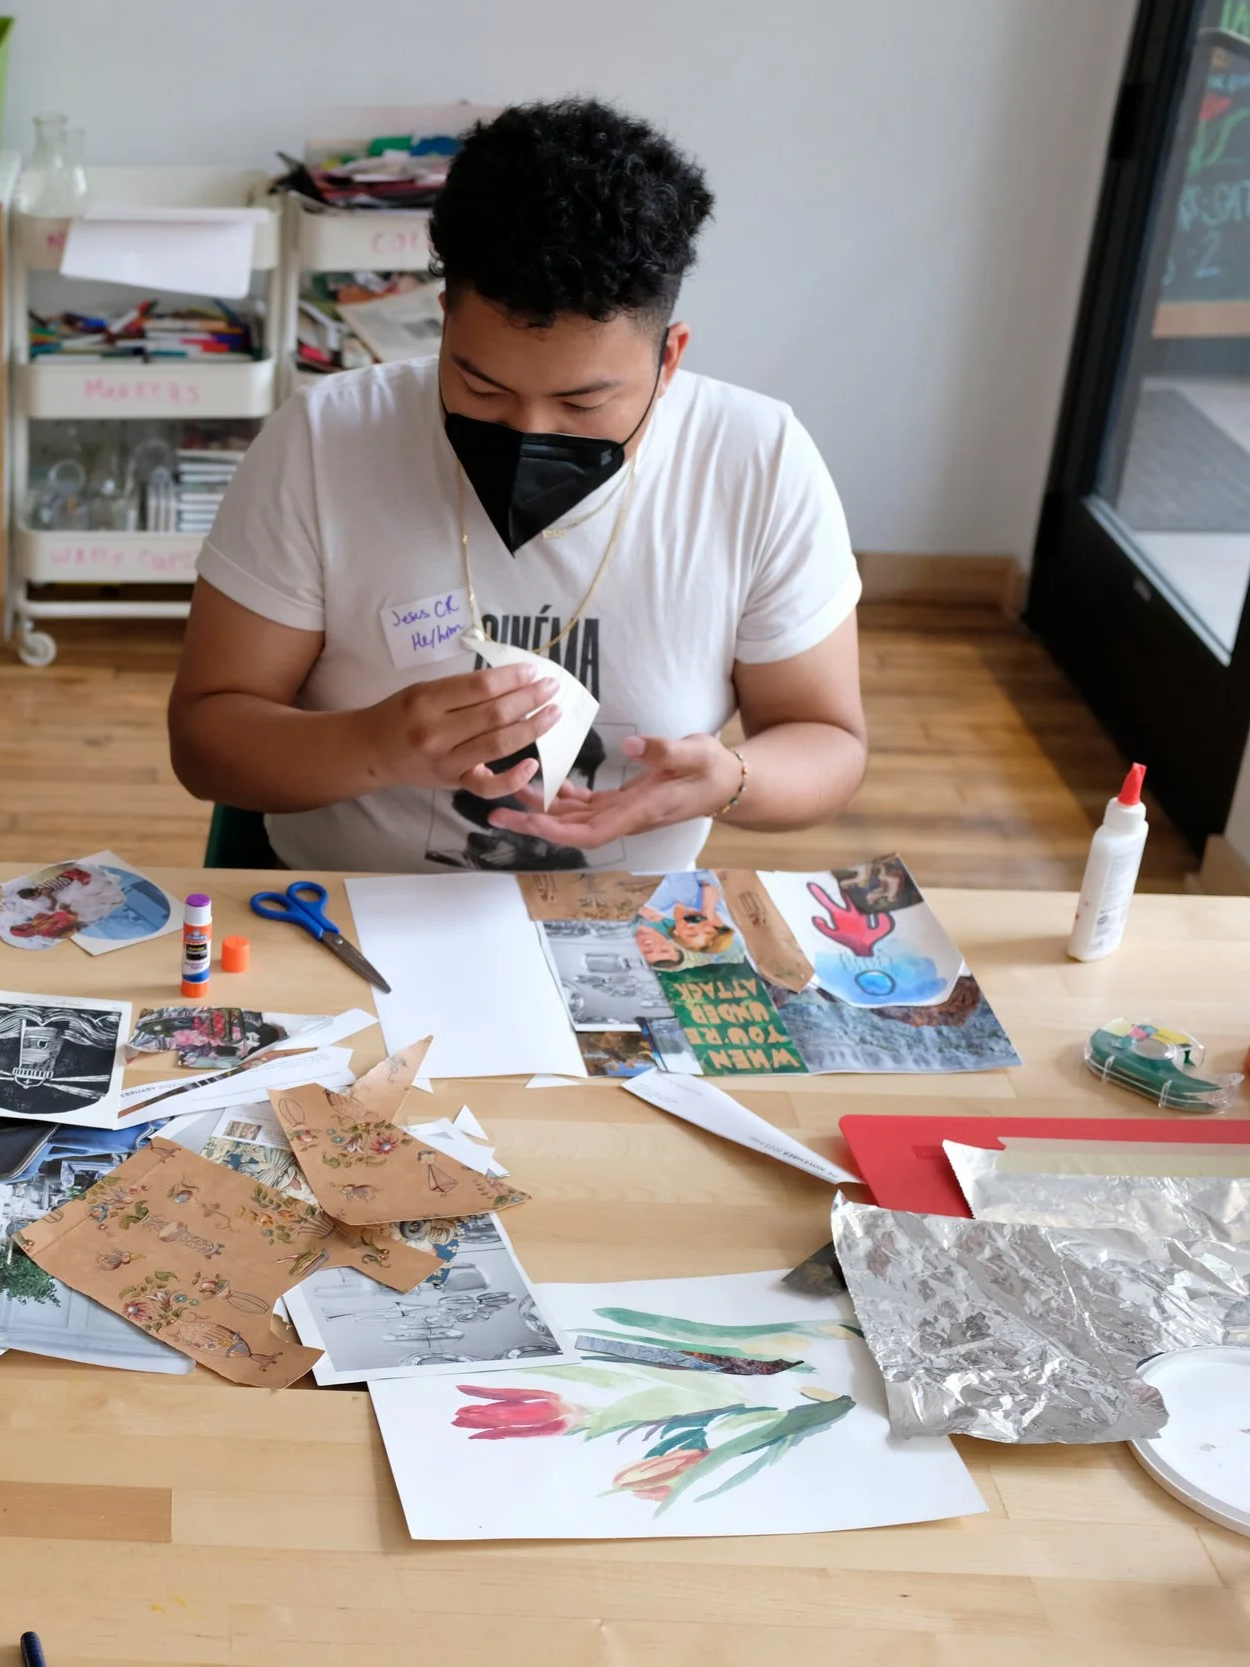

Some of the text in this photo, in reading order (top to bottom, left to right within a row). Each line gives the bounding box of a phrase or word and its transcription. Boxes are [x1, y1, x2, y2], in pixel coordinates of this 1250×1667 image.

[391, 608, 431, 629] Jesus
[673, 980, 757, 1000] ATTACK
[685, 1001, 770, 1024] UNDER
[684, 1025, 790, 1045] YOU'RE
[708, 1048, 801, 1069] WHEN
[120, 1086, 156, 1098] EBRUARY
